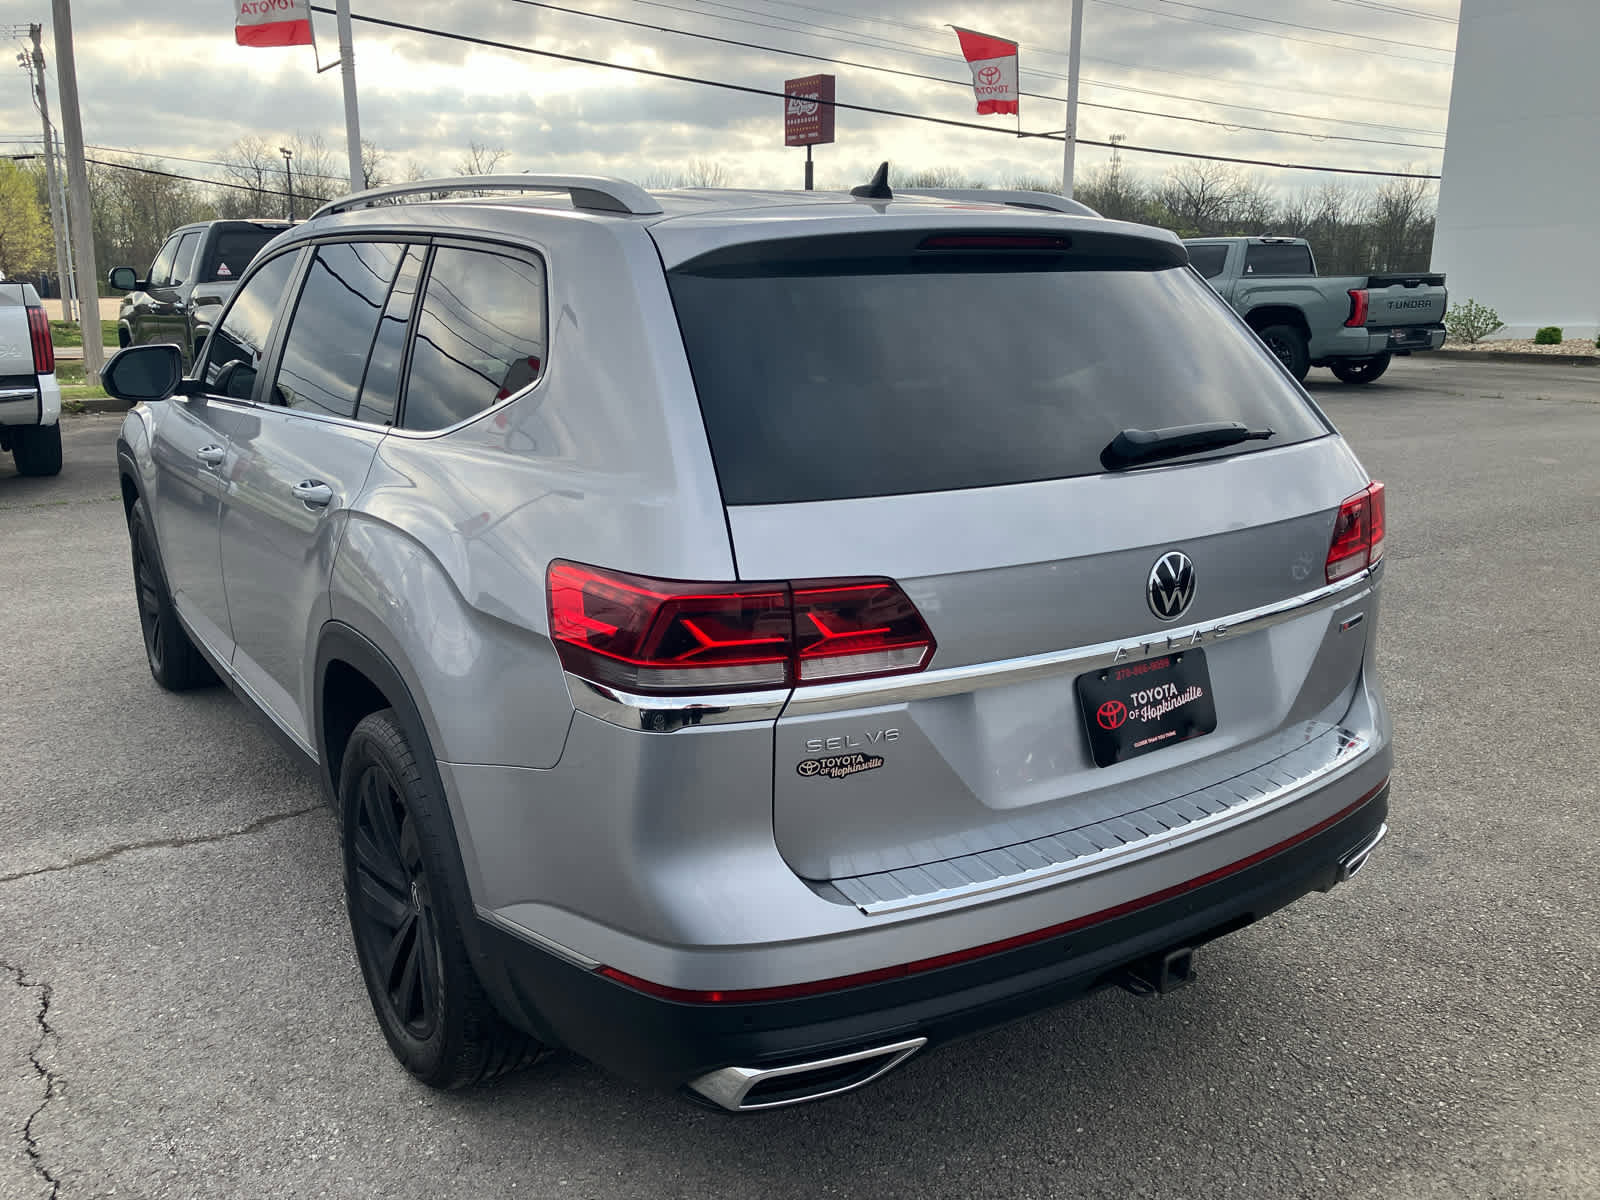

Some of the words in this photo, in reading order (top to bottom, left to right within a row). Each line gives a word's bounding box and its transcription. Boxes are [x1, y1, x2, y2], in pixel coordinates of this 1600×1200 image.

[1388, 299, 1432, 309] TUNDRA
[1113, 624, 1228, 664] ATLAS
[1128, 709, 1140, 720] OF
[1140, 686, 1203, 723] Hopkinsville
[1130, 682, 1178, 708] TOYOTA
[806, 735, 860, 753] SEL
[866, 728, 900, 743] V6
[820, 754, 864, 768] TOYOTA
[830, 758, 883, 777] Hopkinsville
